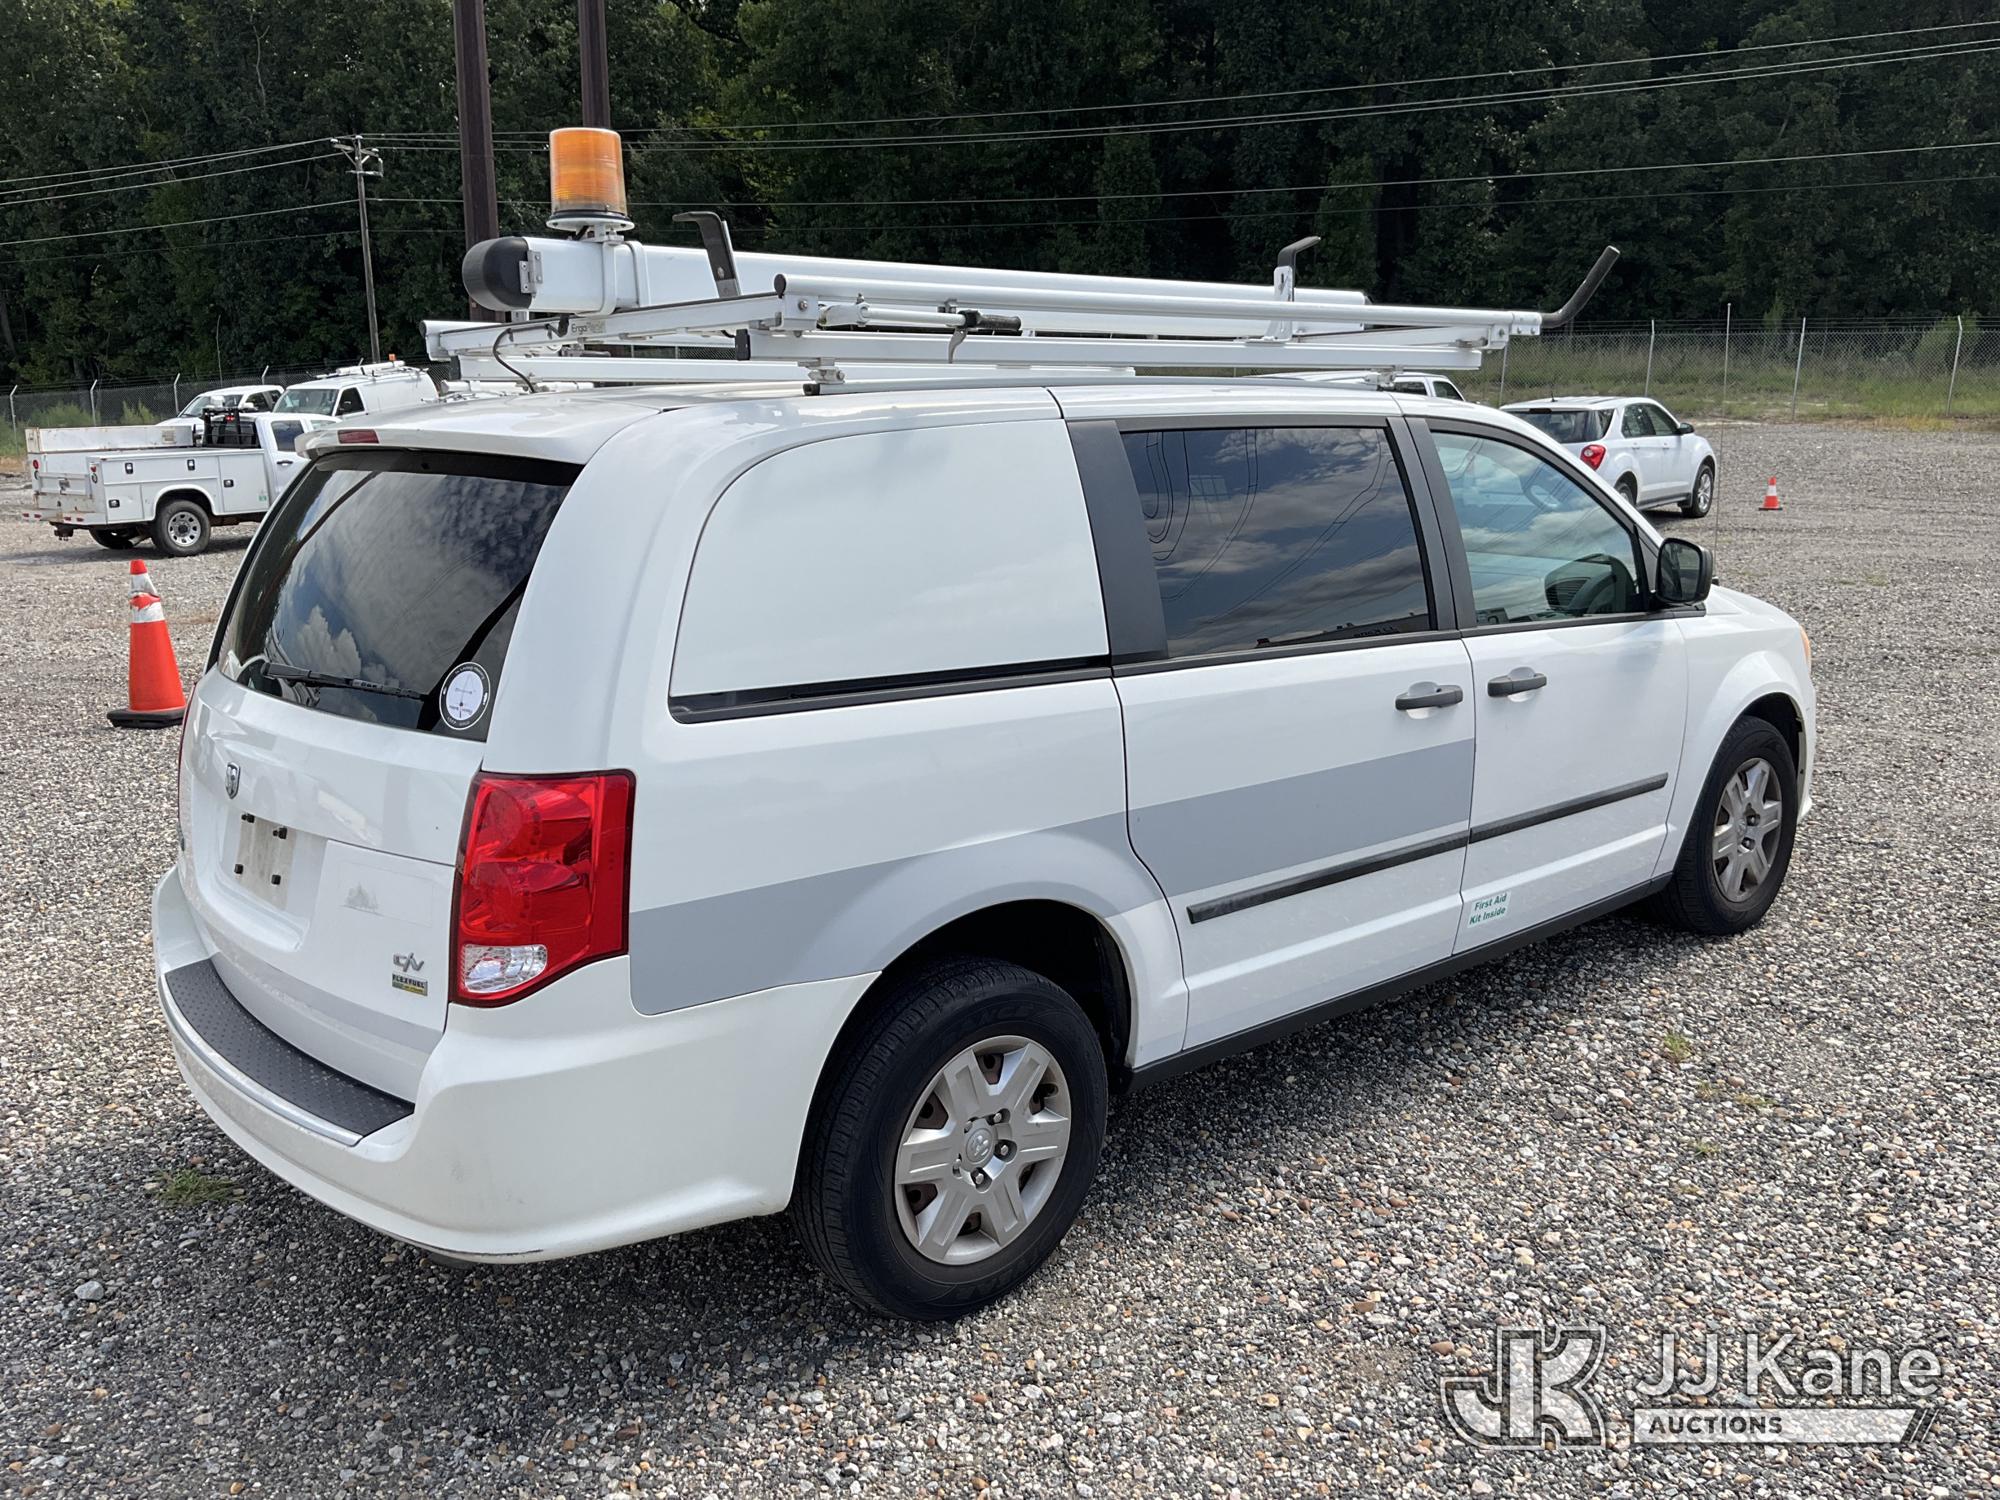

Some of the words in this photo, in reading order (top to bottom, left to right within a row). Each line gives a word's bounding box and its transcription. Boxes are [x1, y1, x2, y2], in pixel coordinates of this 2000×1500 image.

[1474, 899, 1492, 911] First
[1494, 893, 1507, 904] Aid
[1469, 914, 1481, 925] Kit
[1483, 907, 1506, 920] Inside
